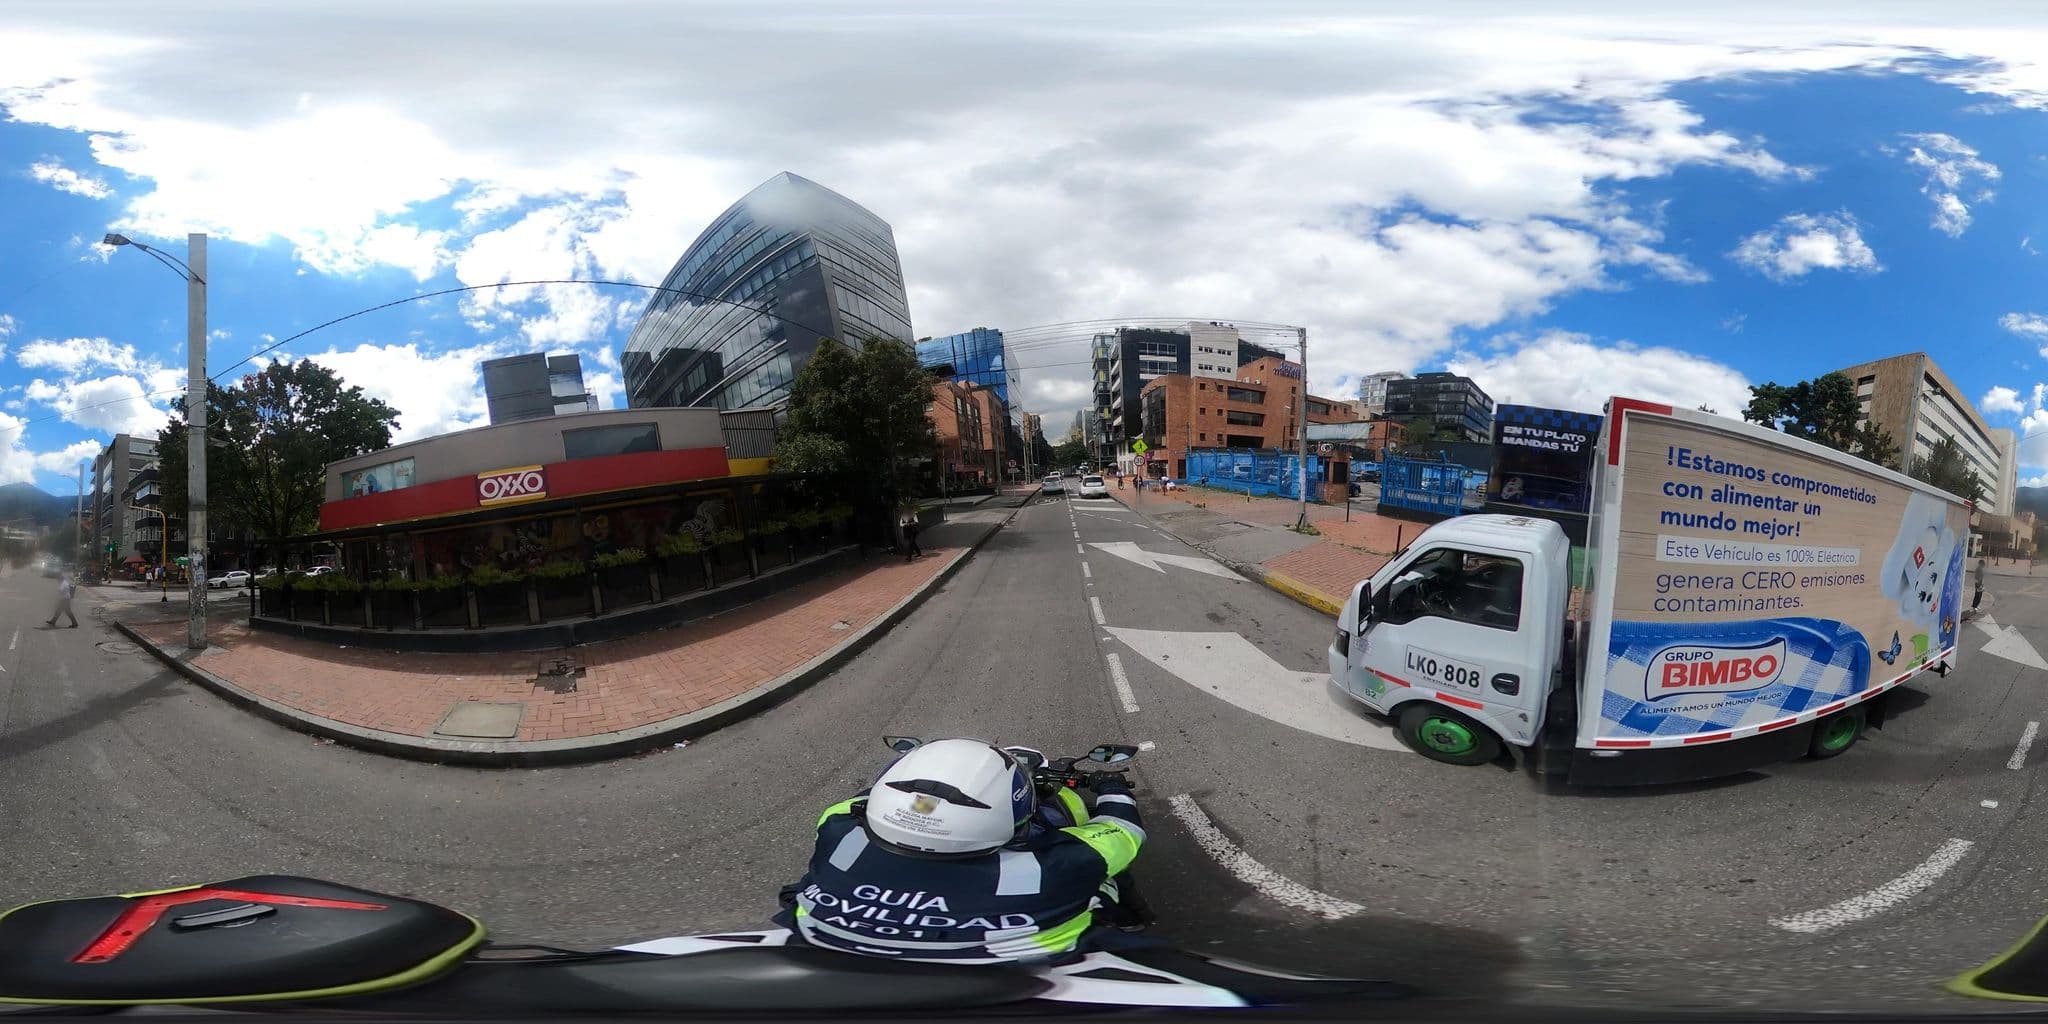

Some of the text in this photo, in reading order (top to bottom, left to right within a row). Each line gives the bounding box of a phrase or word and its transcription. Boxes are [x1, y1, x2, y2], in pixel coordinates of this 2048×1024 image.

[1502, 436, 1580, 452] MANDAS TÚ
[1503, 425, 1586, 443] EN TU PLATO
[480, 471, 543, 500] OXXO
[1667, 446, 1878, 505] !Estamos comprometidos
[1663, 481, 1821, 516] con alimentar un
[1660, 510, 1801, 540] mundo mejor!
[1665, 540, 1699, 559] Este
[1704, 543, 1764, 562] Vehículo
[1767, 551, 1781, 562] es
[1785, 548, 1814, 563] 100%
[1656, 571, 1865, 593] genera CERO emisiones
[1654, 594, 1804, 613] contaminantes.
[1665, 651, 1714, 662] GRUPO
[1661, 654, 1777, 688] BIMBO
[1640, 703, 1709, 714] ALIMENTAMOS
[1725, 696, 1755, 707] MUNDO
[1756, 692, 1782, 702] MEJOR
[803, 884, 1036, 930] MOVILIDAD
[853, 884, 949, 912] GUÍA
